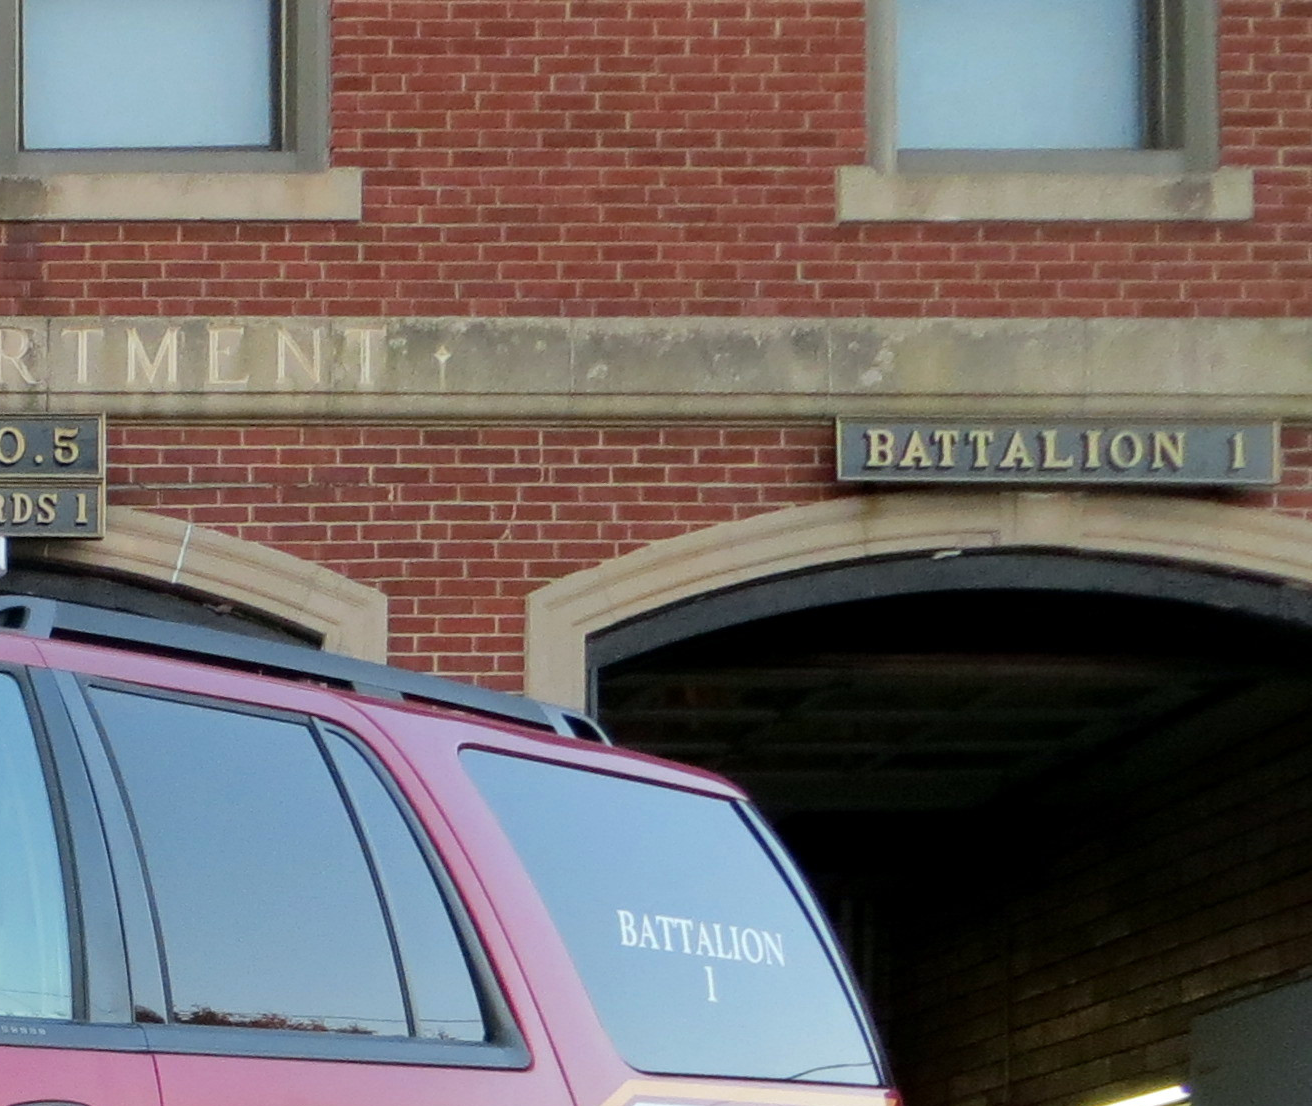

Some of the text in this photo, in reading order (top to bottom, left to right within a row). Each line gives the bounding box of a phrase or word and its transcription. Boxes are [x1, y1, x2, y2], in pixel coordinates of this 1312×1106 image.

[865, 429, 1247, 469] BATTALION 1
[75, 493, 89, 524] 1
[615, 908, 786, 967] BATTALION
[703, 965, 719, 1003] 1
